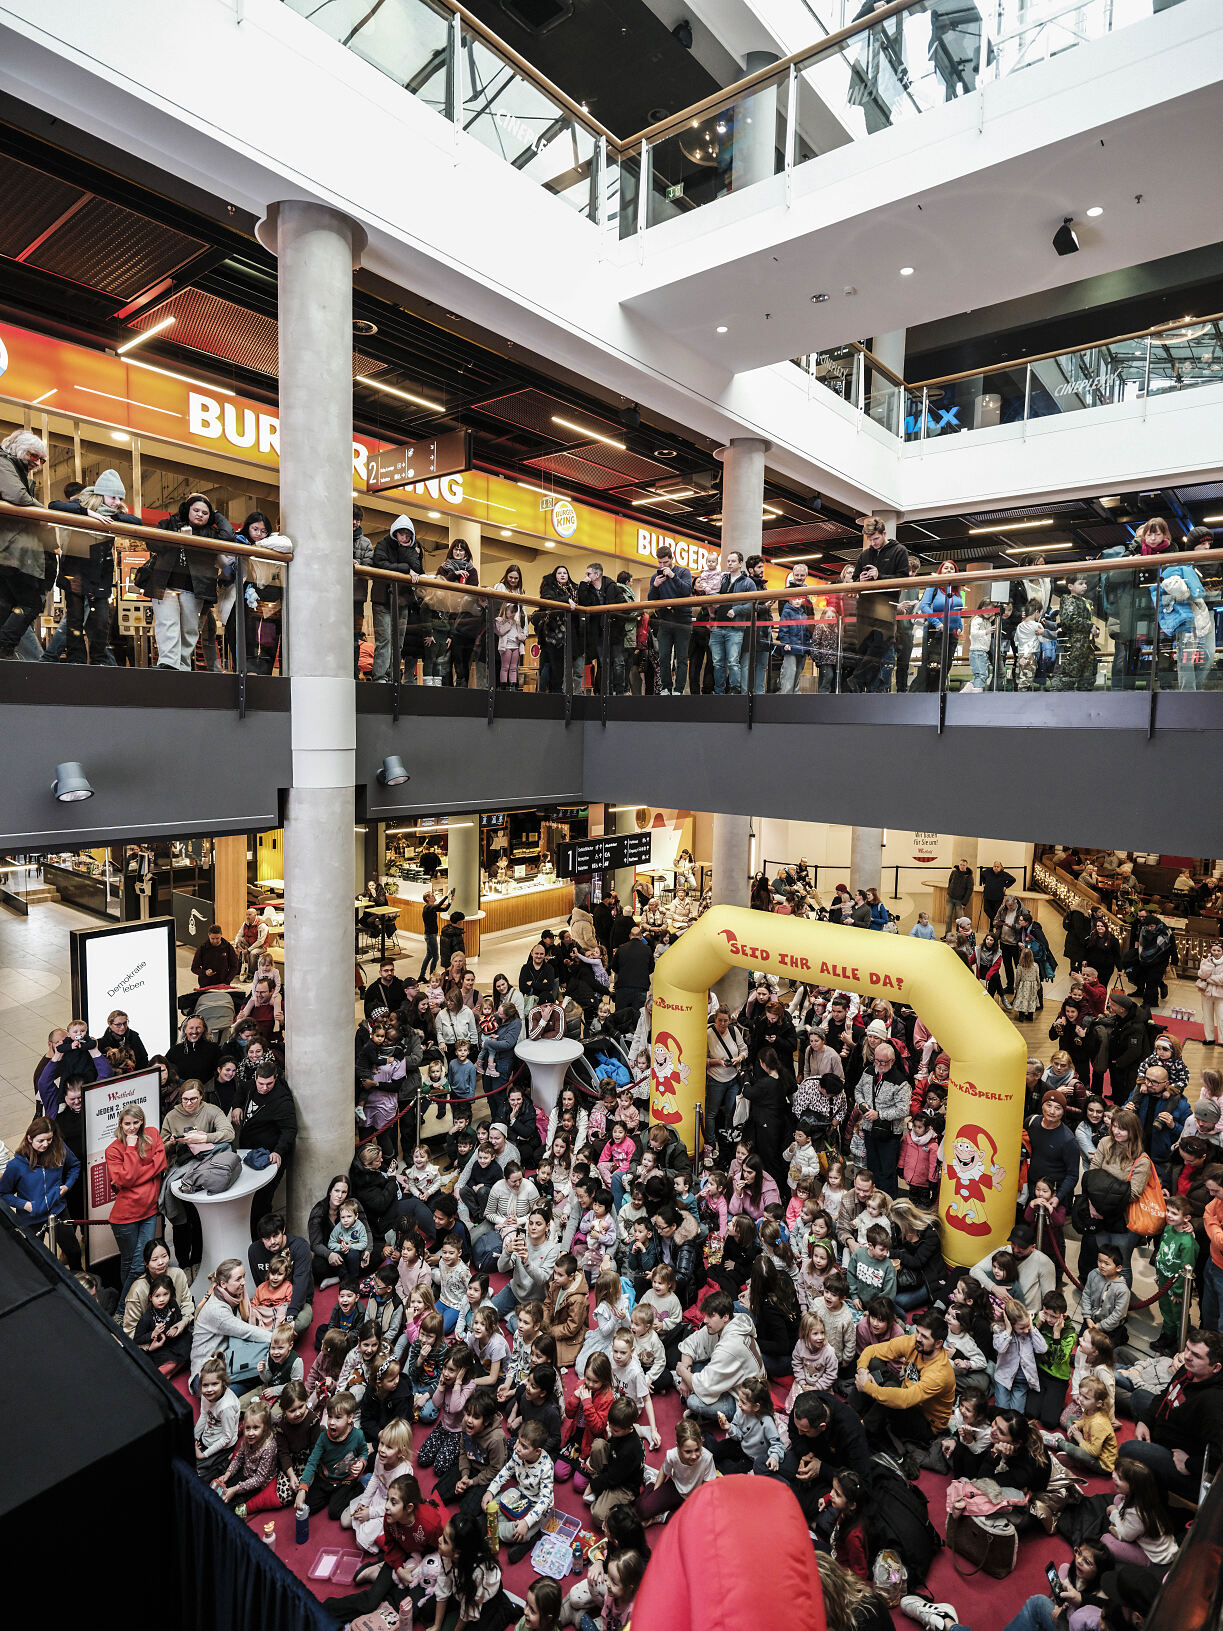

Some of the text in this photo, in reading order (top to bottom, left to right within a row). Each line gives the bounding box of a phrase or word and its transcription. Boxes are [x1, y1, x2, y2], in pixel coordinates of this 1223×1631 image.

[1054, 367, 1123, 397] CINEPLEXX
[369, 461, 377, 484] 2
[557, 515, 576, 528] KING
[567, 850, 573, 870] 1
[730, 942, 905, 991] SEID IHR ALLE DA?
[107, 961, 147, 998] Demokratie
[123, 980, 145, 993] leben
[96, 1105, 114, 1117] JEDEN
[115, 1104, 122, 1112] 2.
[107, 1113, 116, 1121] IM
